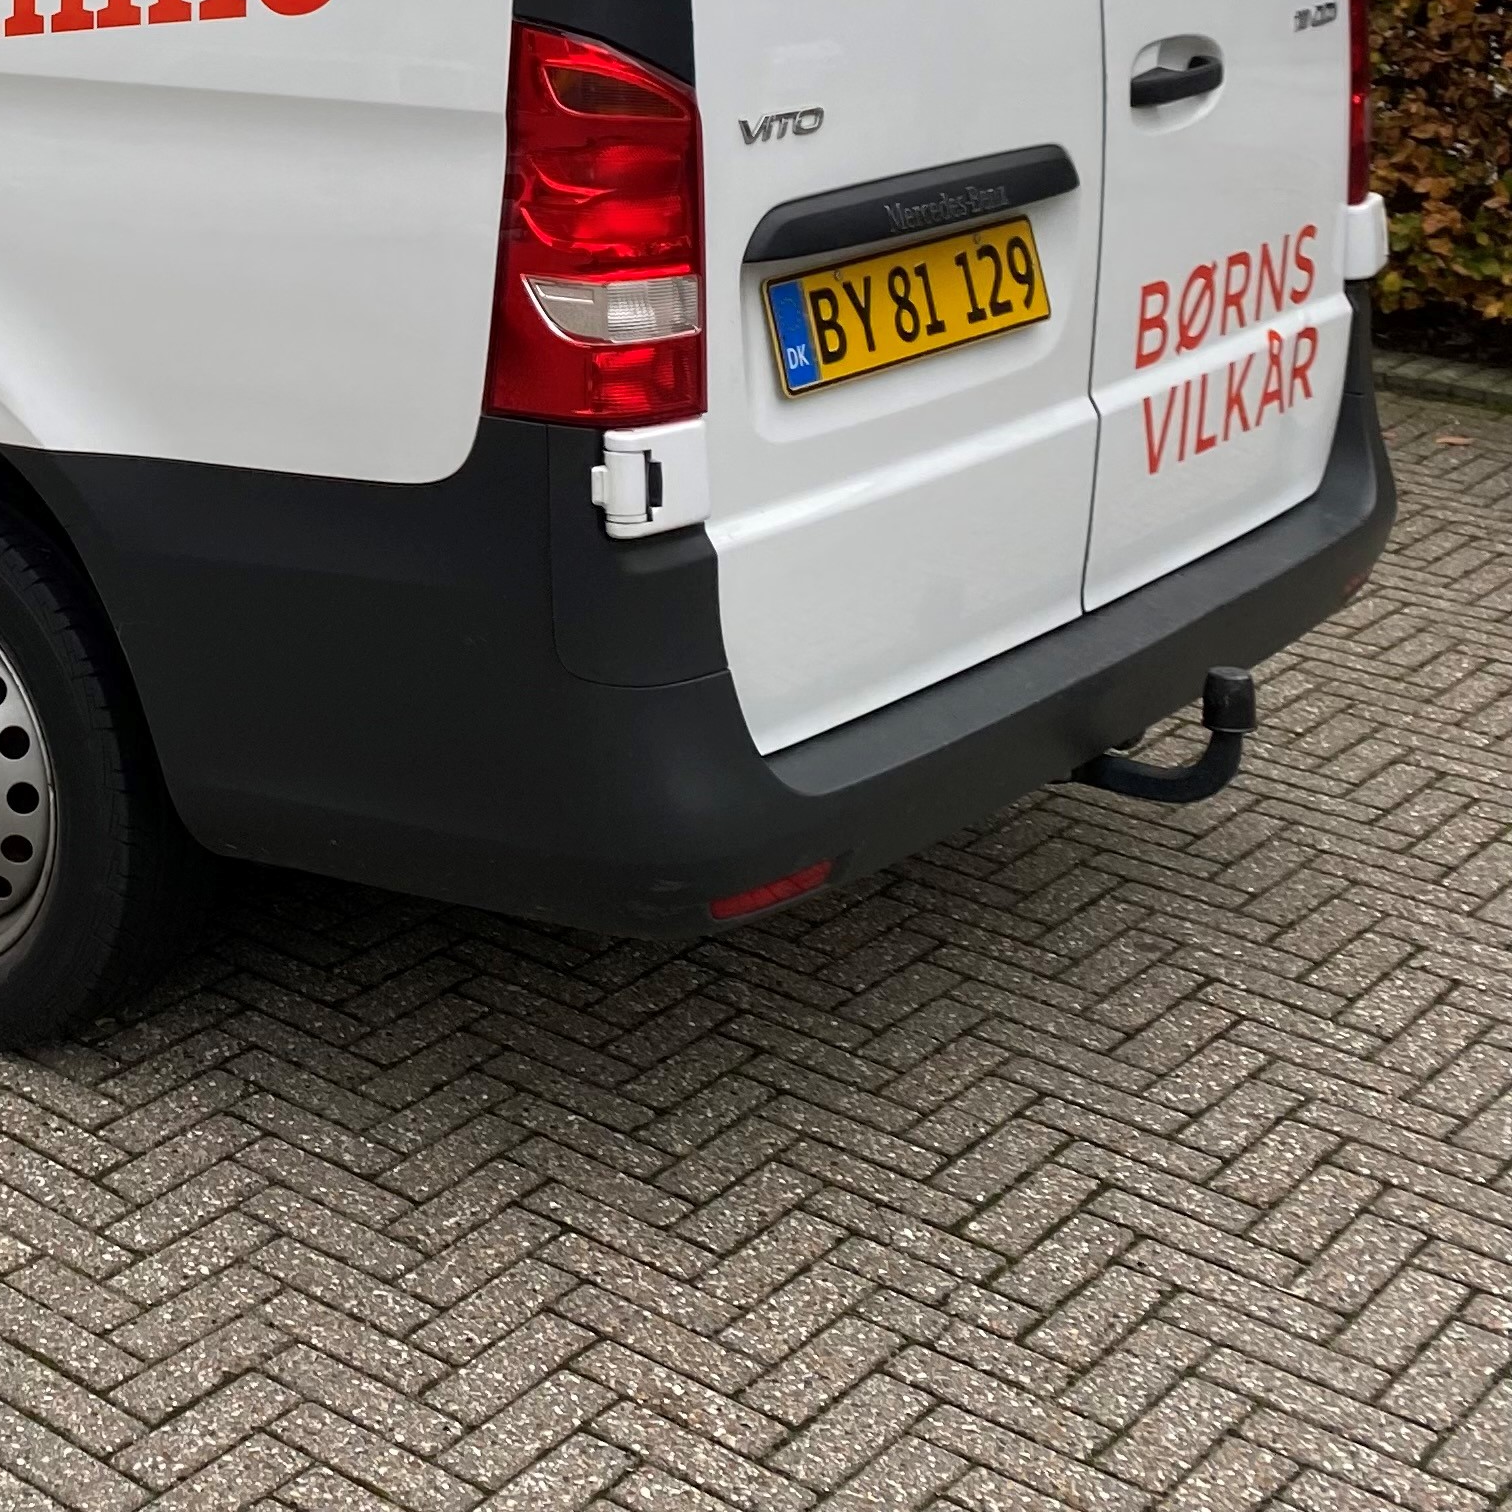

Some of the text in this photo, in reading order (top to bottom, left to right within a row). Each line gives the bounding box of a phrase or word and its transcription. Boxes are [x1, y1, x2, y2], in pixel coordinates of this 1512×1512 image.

[738, 106, 825, 146] VITO
[786, 344, 810, 369] DK
[809, 235, 1037, 365] BY 81 129
[1135, 224, 1317, 369] BØRNS
[1143, 326, 1319, 475] VILKÅR
